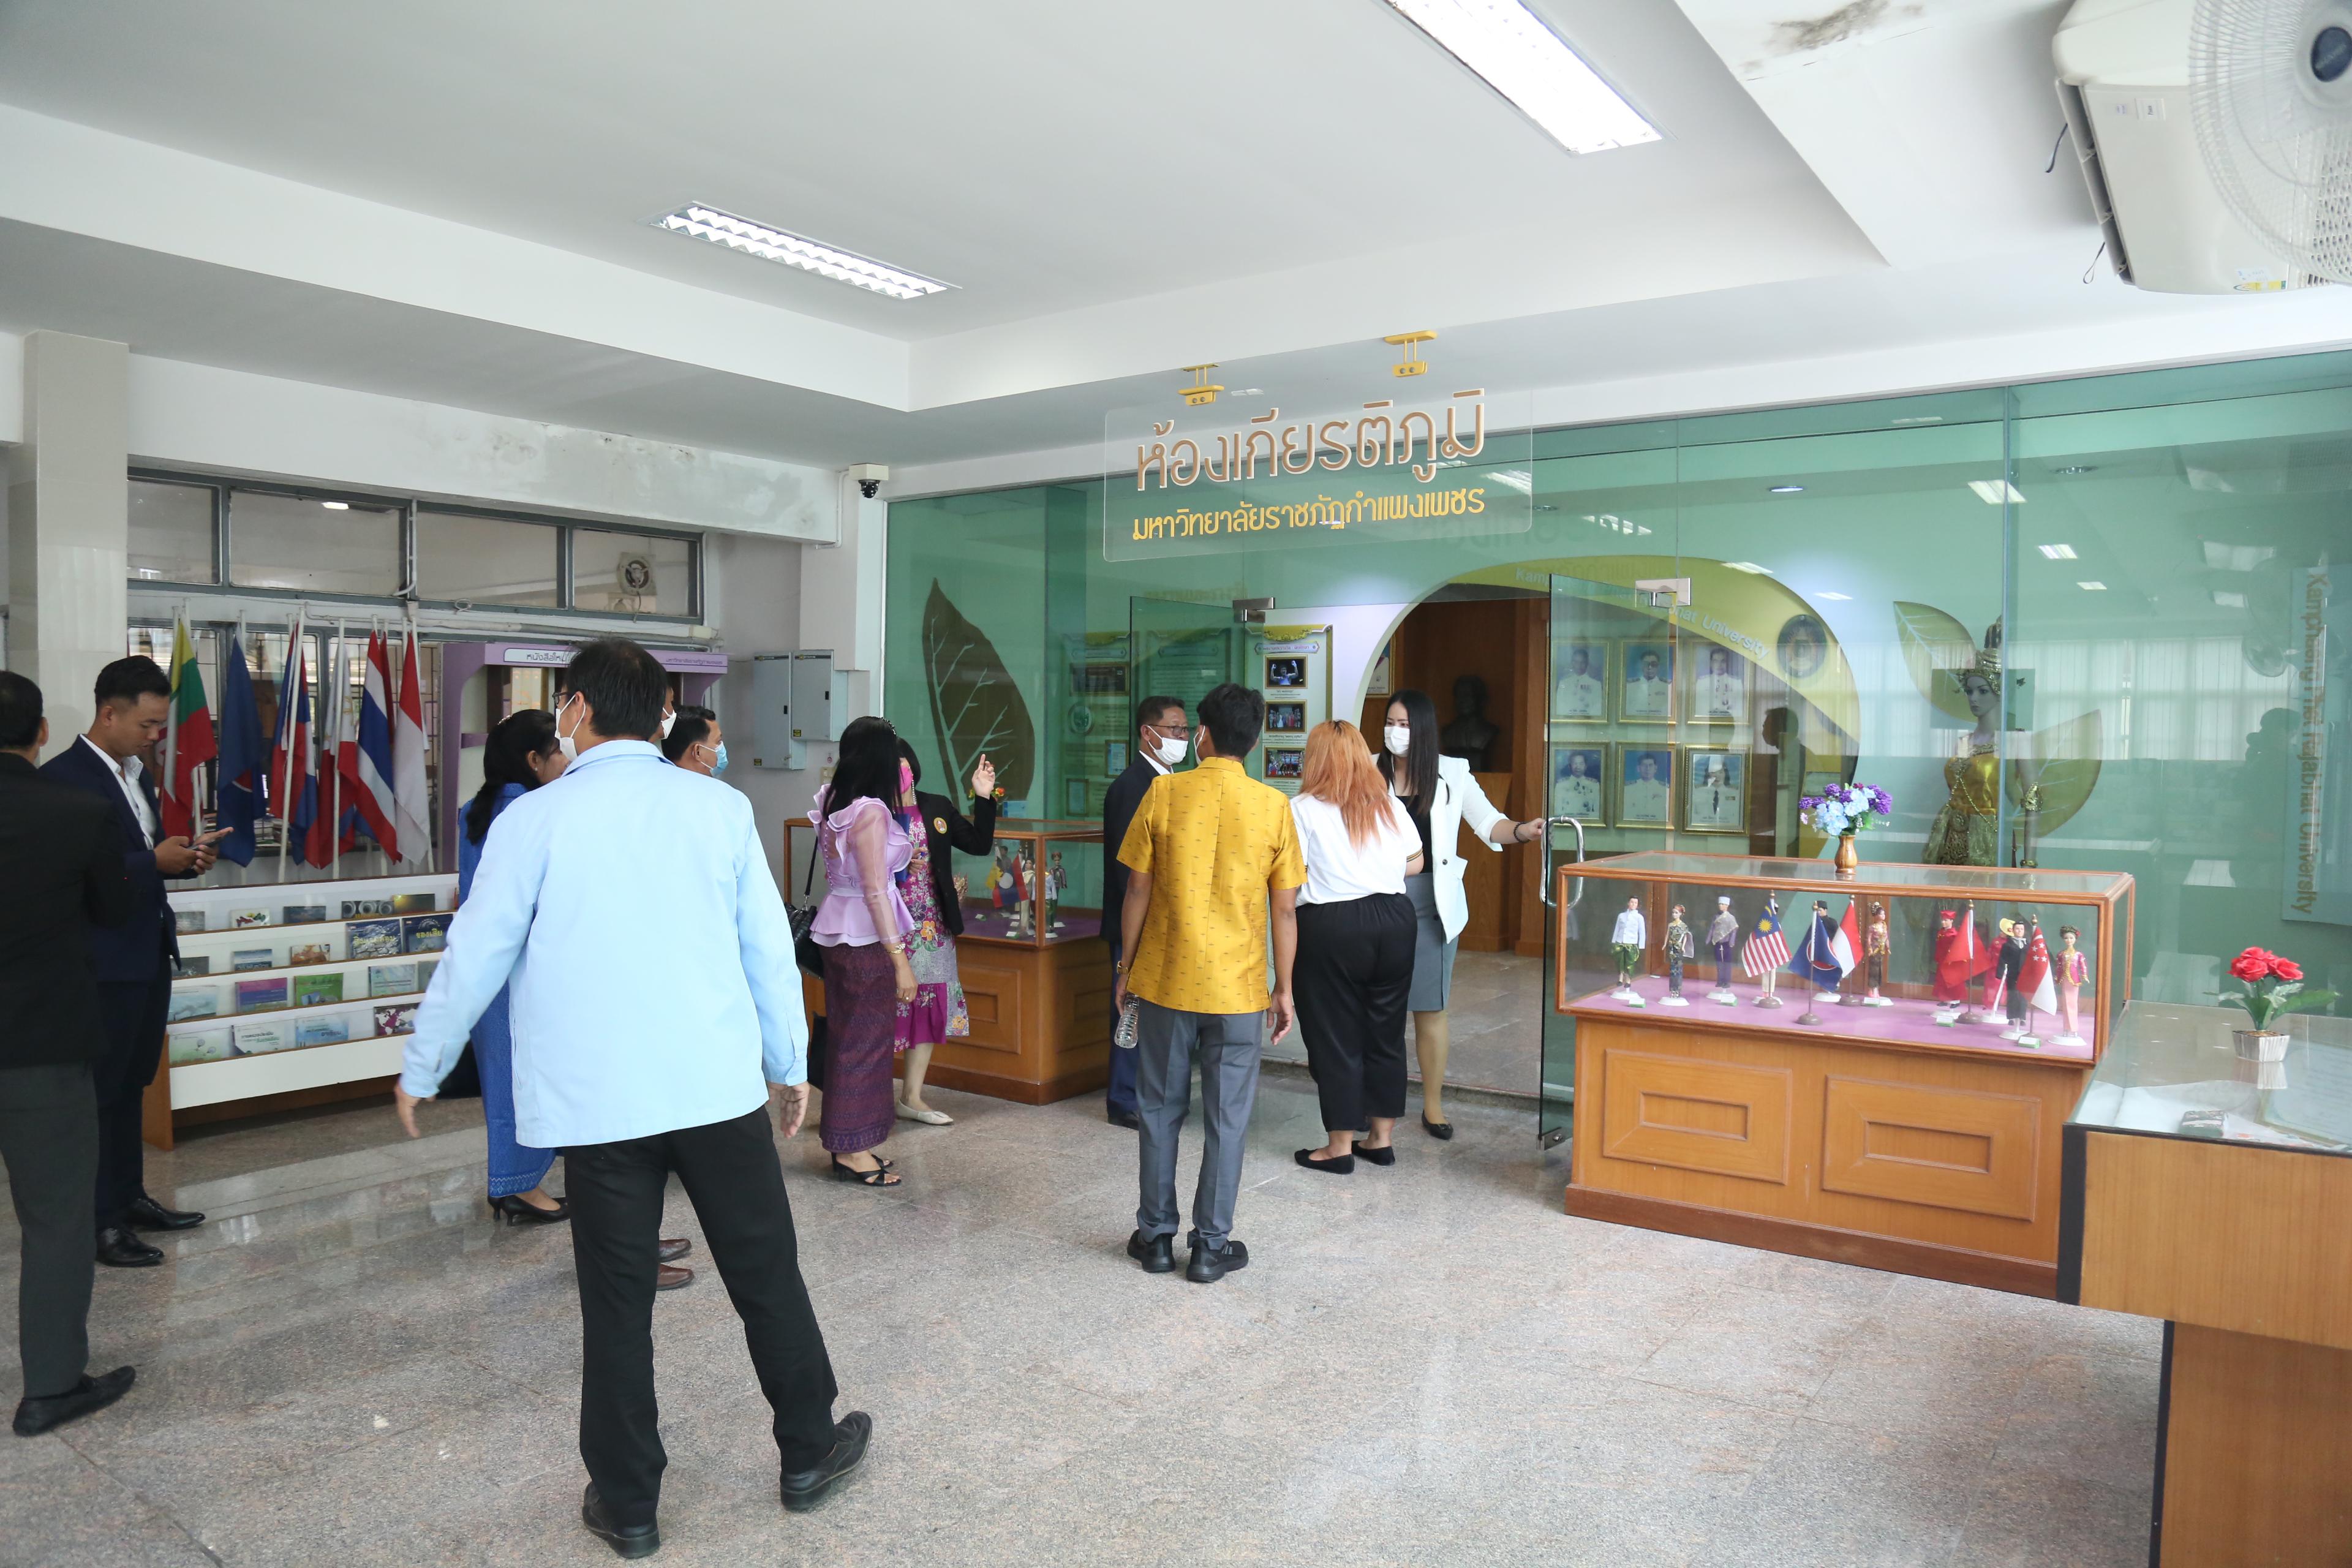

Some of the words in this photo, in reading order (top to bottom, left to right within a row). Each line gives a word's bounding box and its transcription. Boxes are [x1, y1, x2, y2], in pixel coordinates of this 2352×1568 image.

[1137, 388, 1485, 491] ห้องเกียรติภูมิ
[1133, 488, 1485, 540] มหาวิทยาลัยราชภัฏกำแพงเพชร
[1702, 614, 1770, 660] University
[2297, 733, 2324, 815] Rajabhat
[2291, 822, 2322, 915] University
